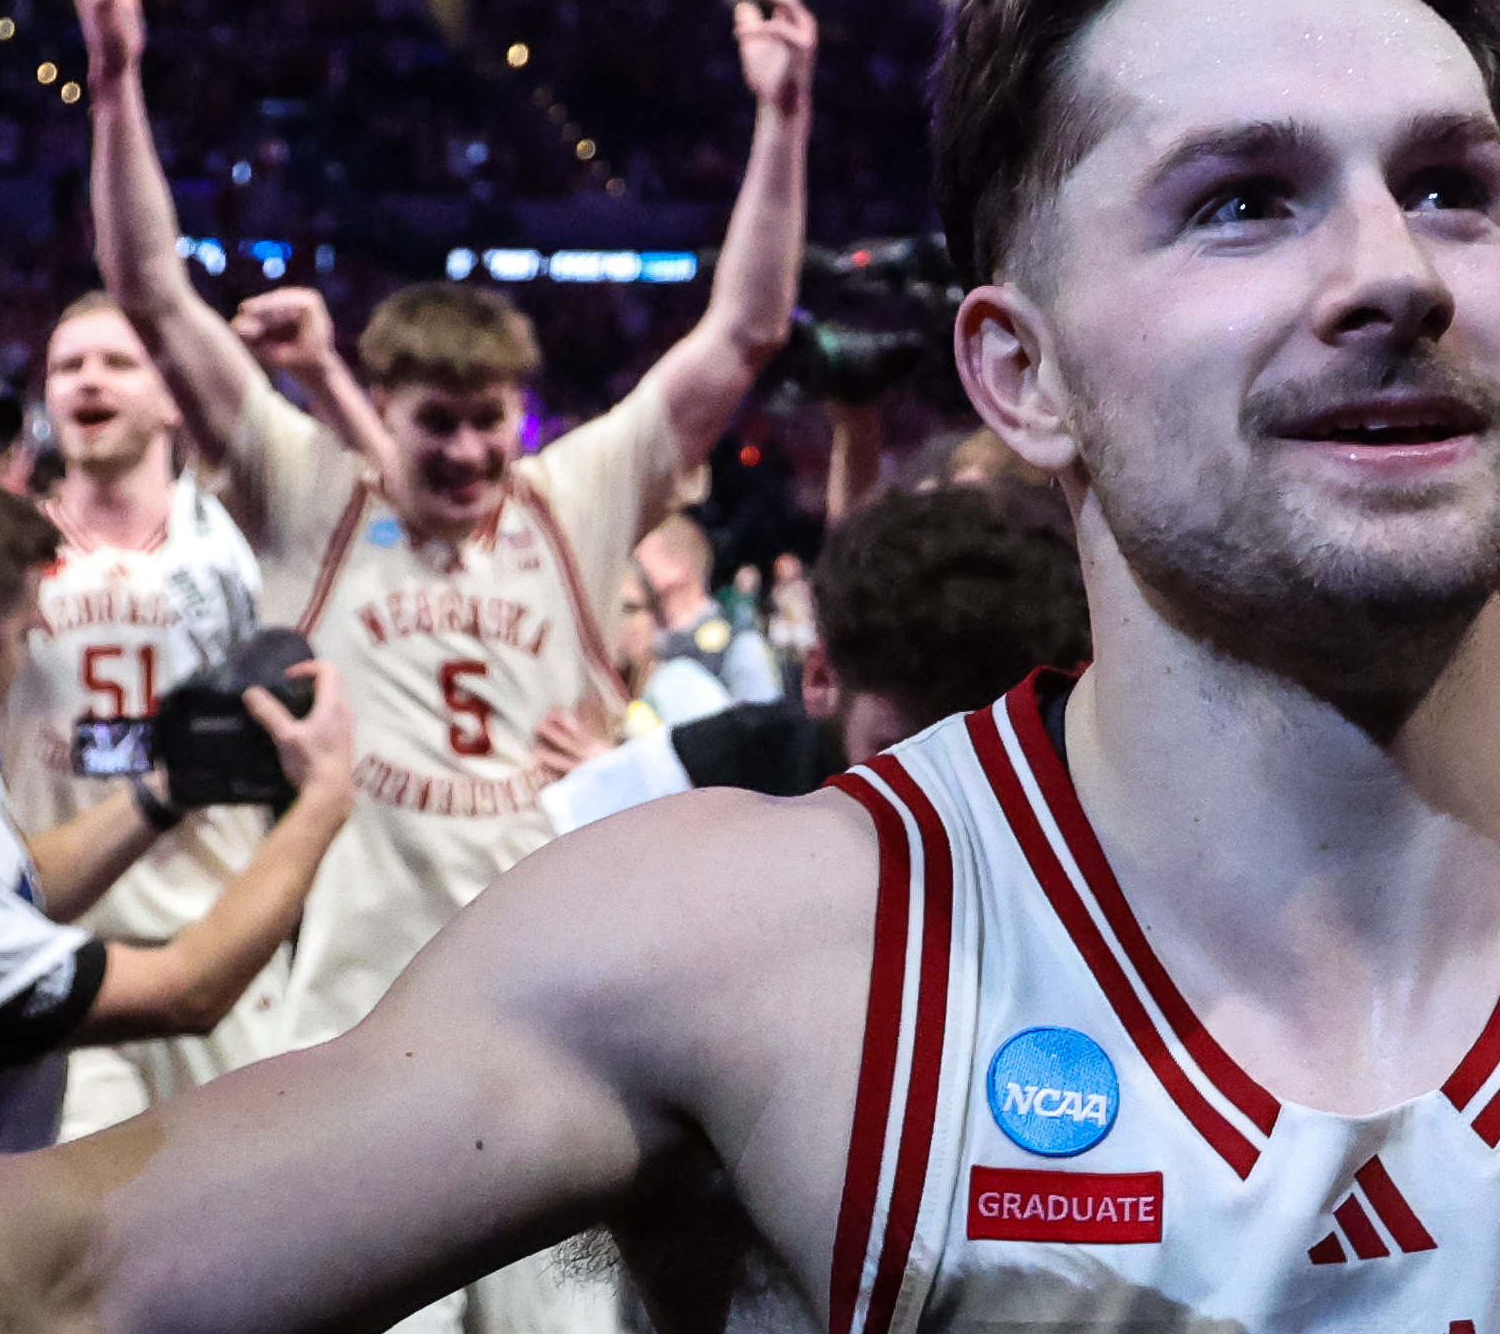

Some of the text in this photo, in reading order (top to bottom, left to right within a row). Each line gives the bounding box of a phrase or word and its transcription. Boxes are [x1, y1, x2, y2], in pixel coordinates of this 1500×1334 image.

[80, 643, 162, 717] 51
[438, 660, 492, 756] 5
[1002, 1081, 1108, 1127] NCAA
[977, 1191, 1156, 1223] GRADUATE
